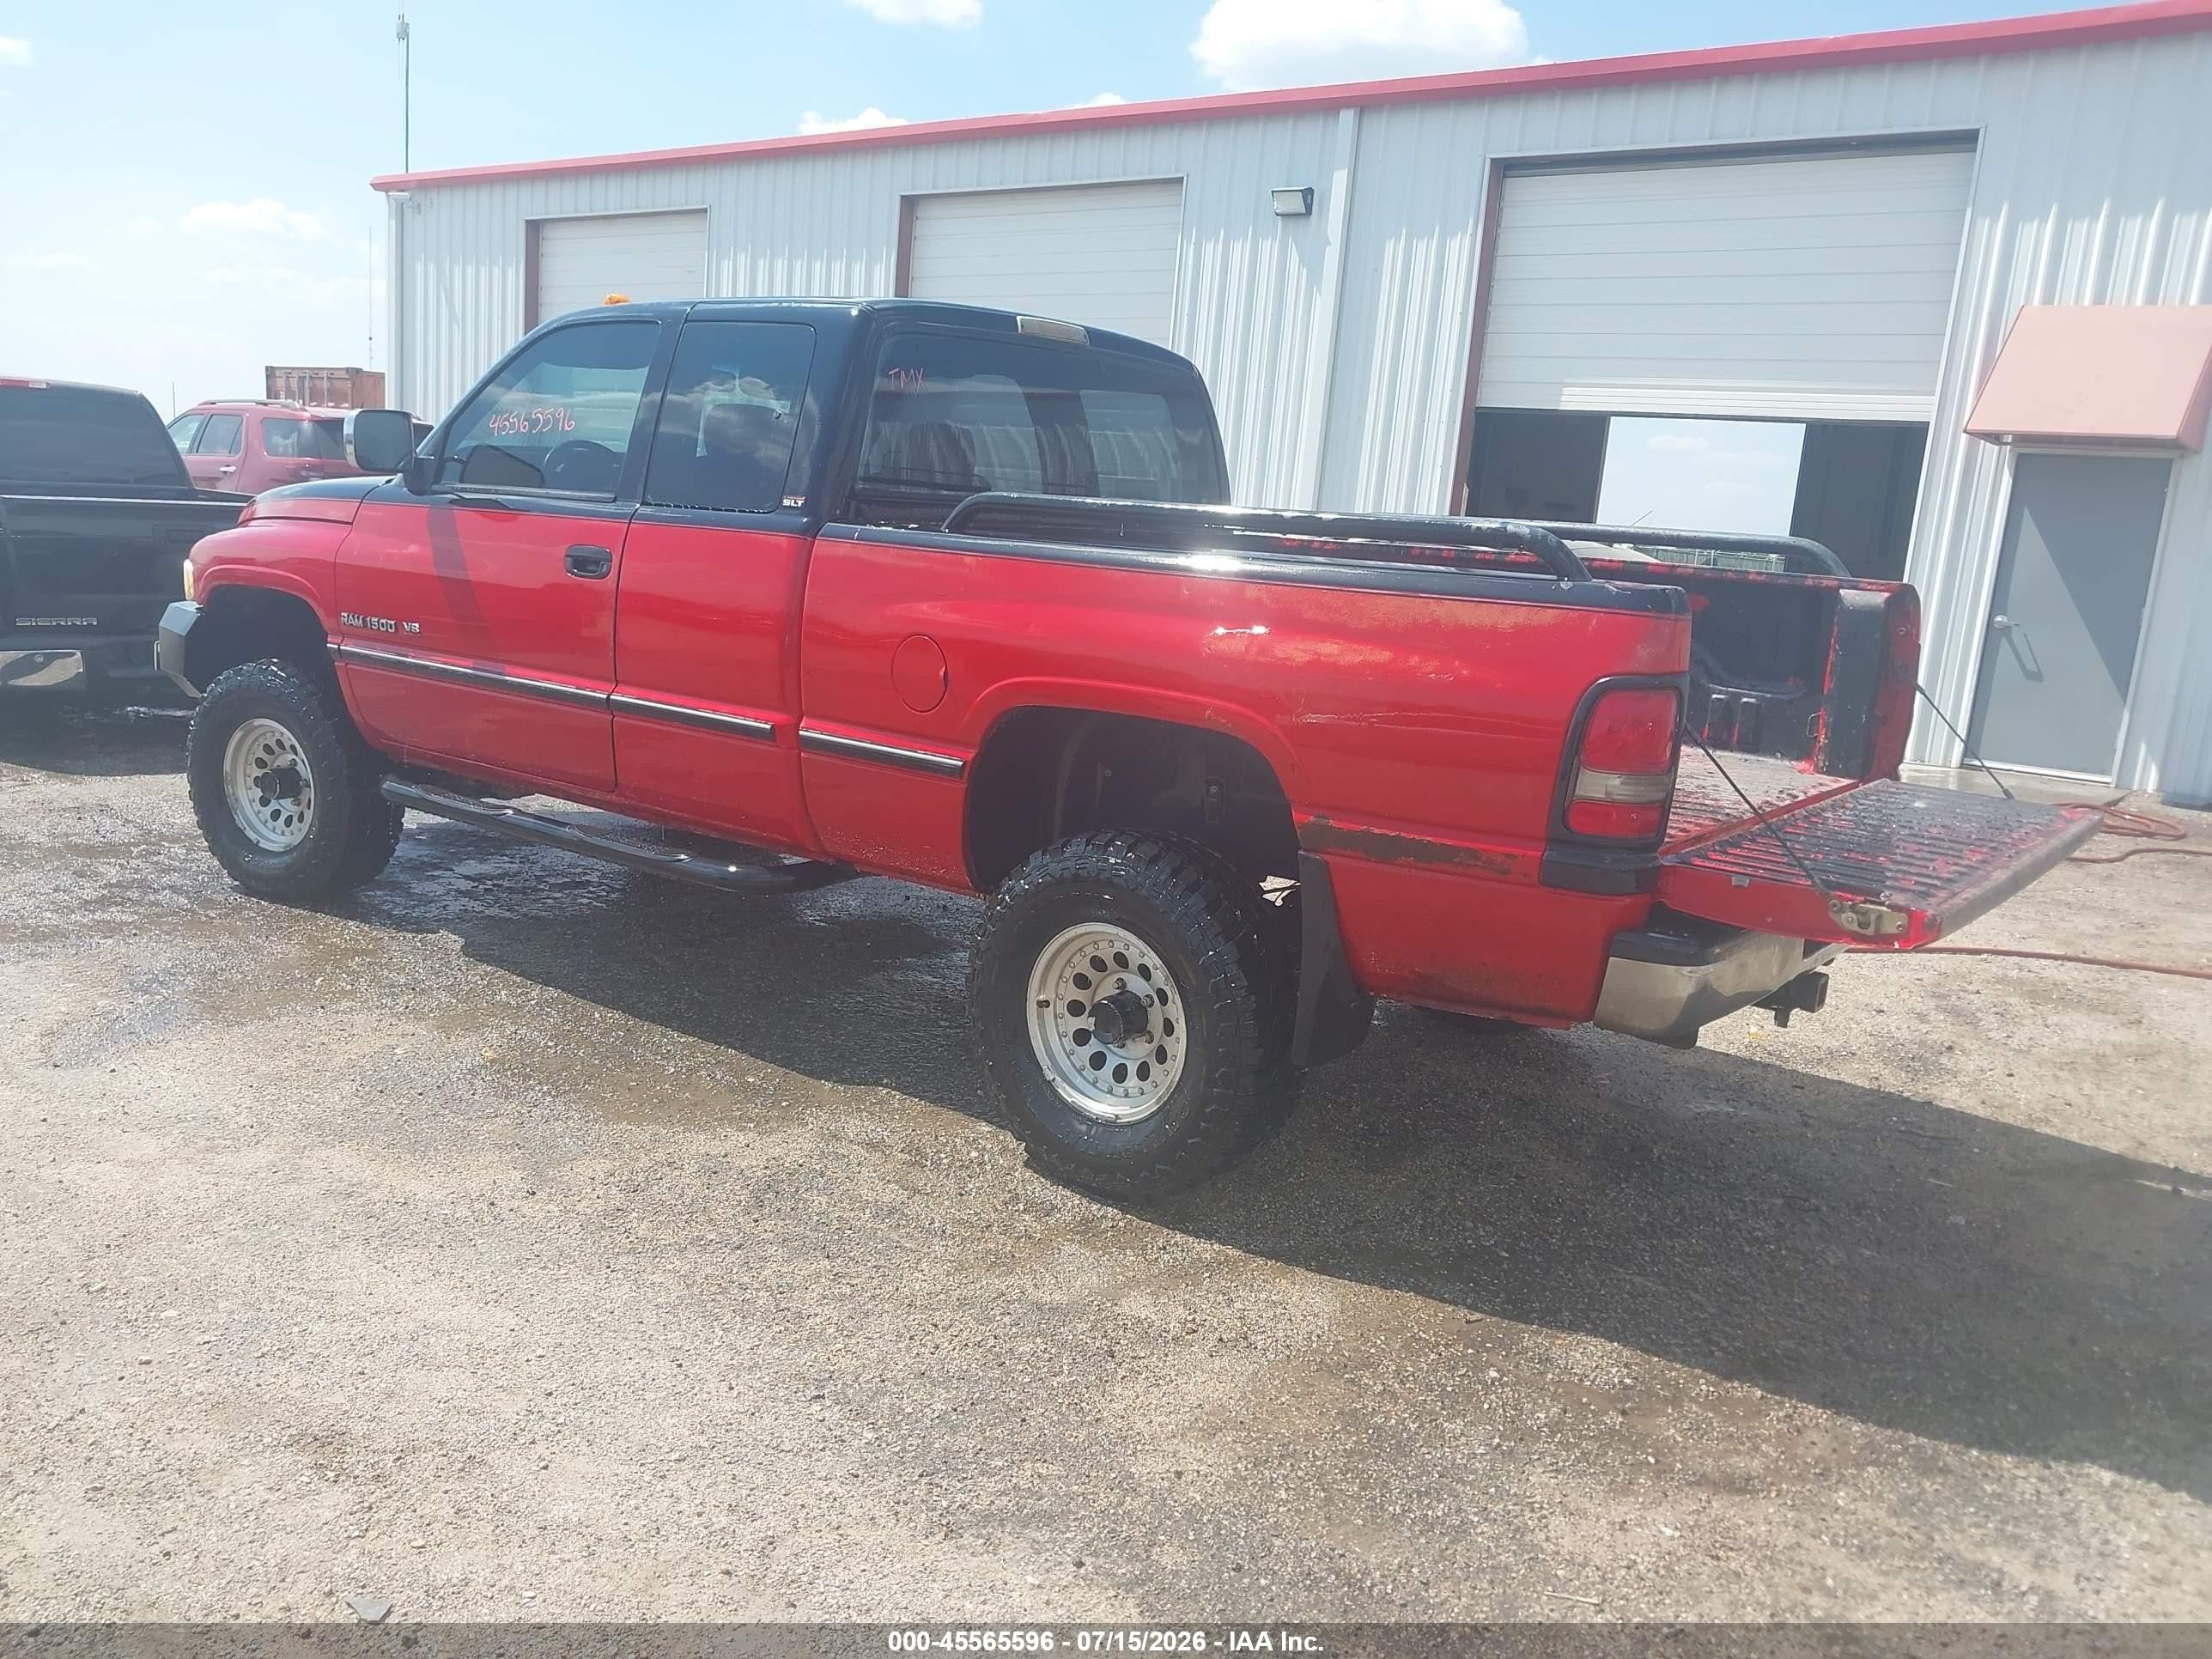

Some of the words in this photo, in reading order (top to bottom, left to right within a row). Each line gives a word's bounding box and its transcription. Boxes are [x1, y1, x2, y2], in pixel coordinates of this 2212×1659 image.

[489, 407, 575, 437] 45565596
[782, 499, 805, 507] SLT
[15, 617, 98, 626] SIERRA
[340, 611, 364, 628] RAM
[366, 616, 397, 633] 1500
[402, 621, 420, 634] V8
